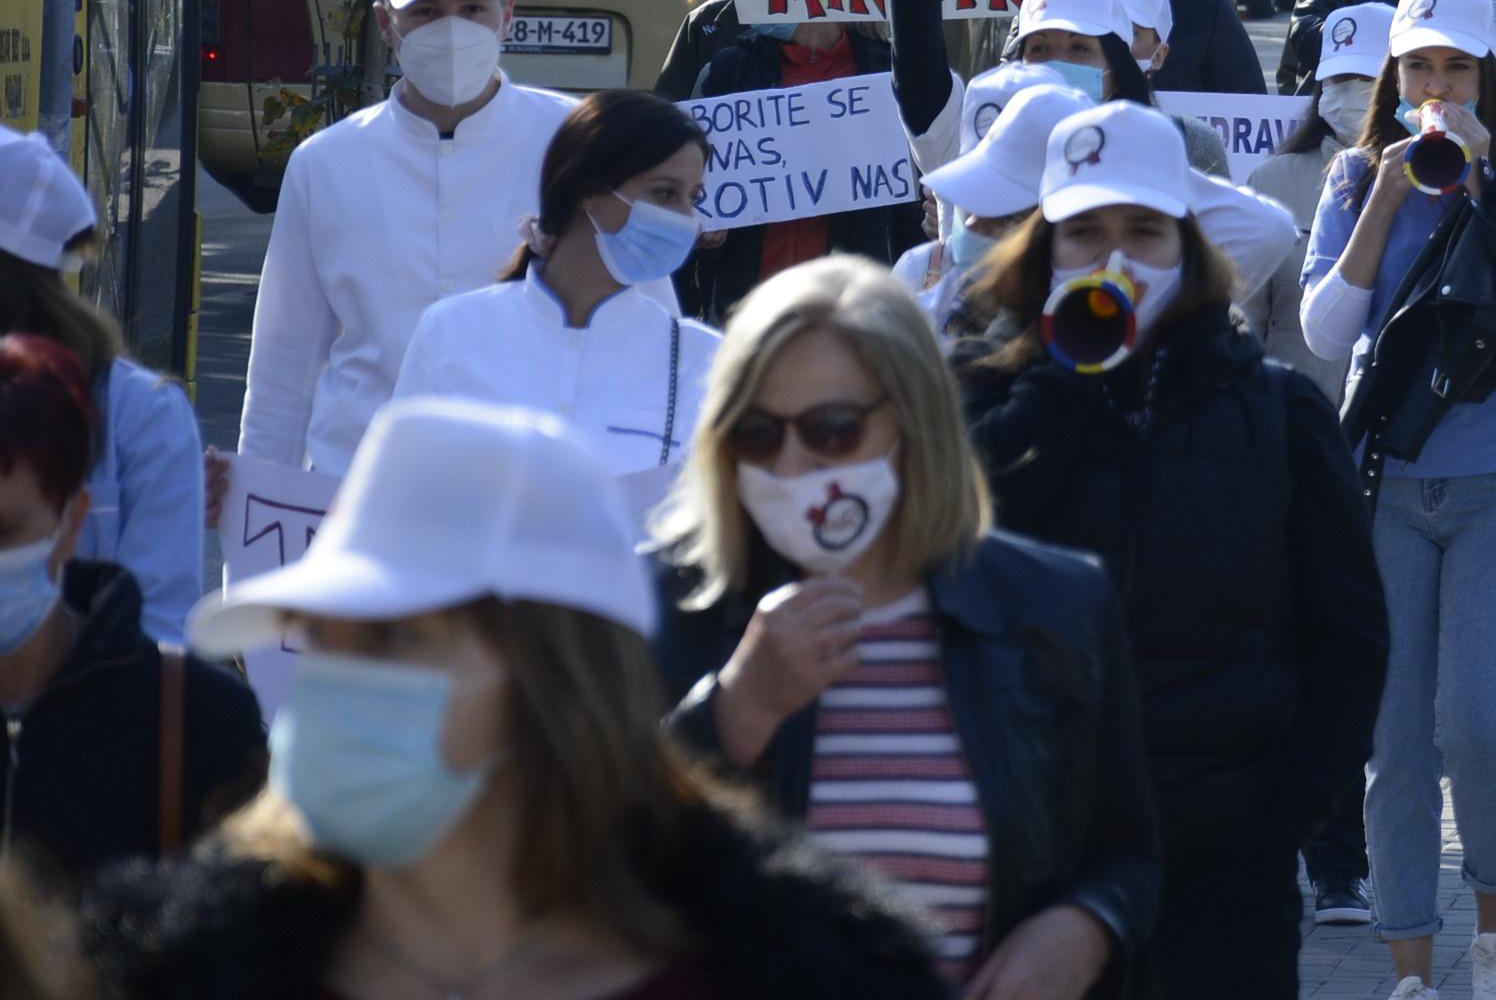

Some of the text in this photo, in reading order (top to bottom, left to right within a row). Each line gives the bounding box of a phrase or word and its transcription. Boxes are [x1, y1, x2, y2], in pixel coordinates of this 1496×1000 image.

[691, 85, 870, 136] BORITE SE
[707, 136, 787, 169] NAS,
[850, 158, 910, 202] NAS
